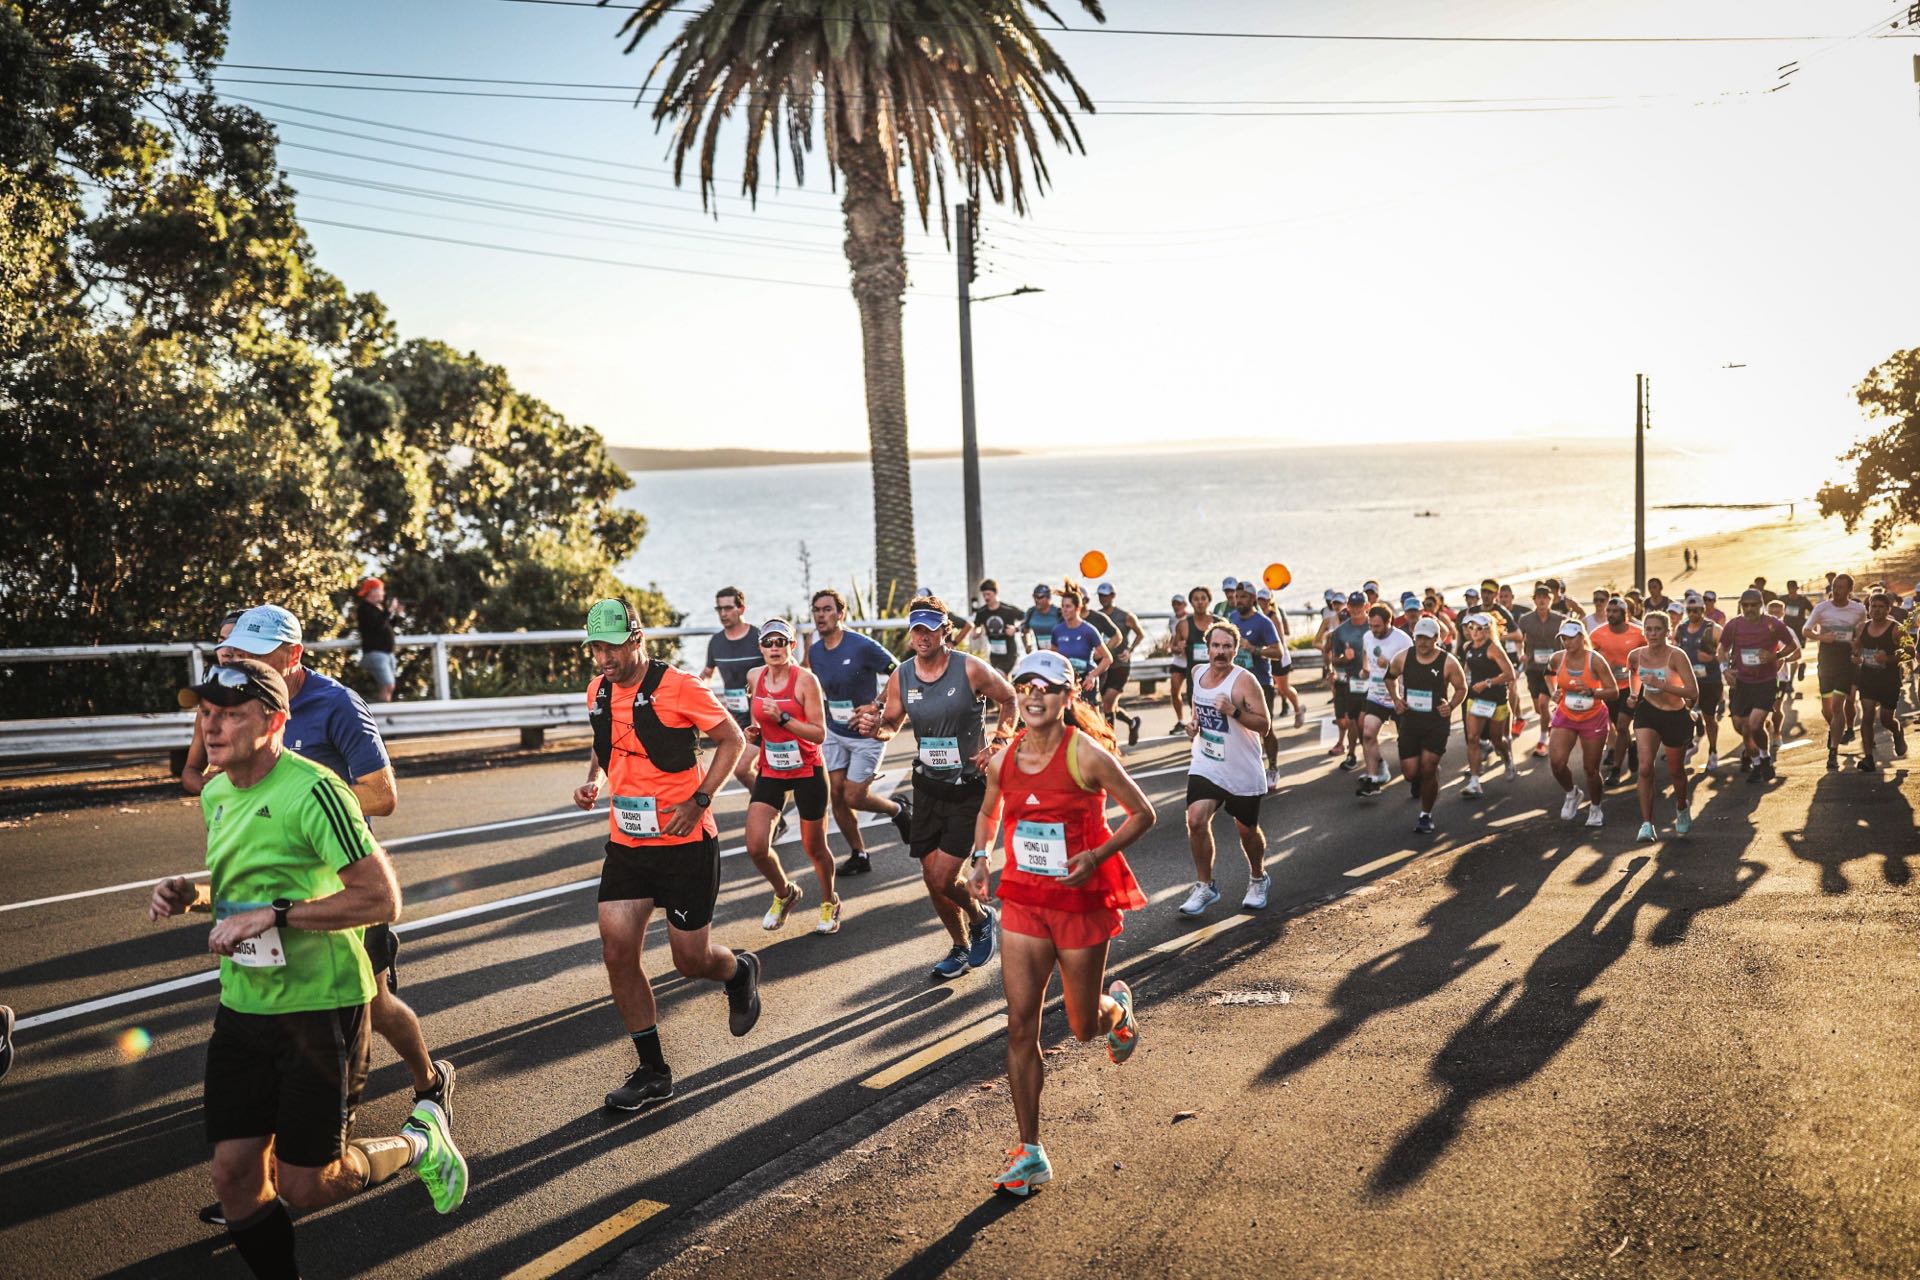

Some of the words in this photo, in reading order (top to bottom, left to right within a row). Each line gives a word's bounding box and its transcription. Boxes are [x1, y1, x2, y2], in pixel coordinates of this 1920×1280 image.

[1194, 706, 1222, 719] OLICE
[1213, 719, 1223, 730] 7
[1024, 841, 1040, 852] HONG
[1041, 843, 1049, 853] LU
[1028, 855, 1047, 866] 21309
